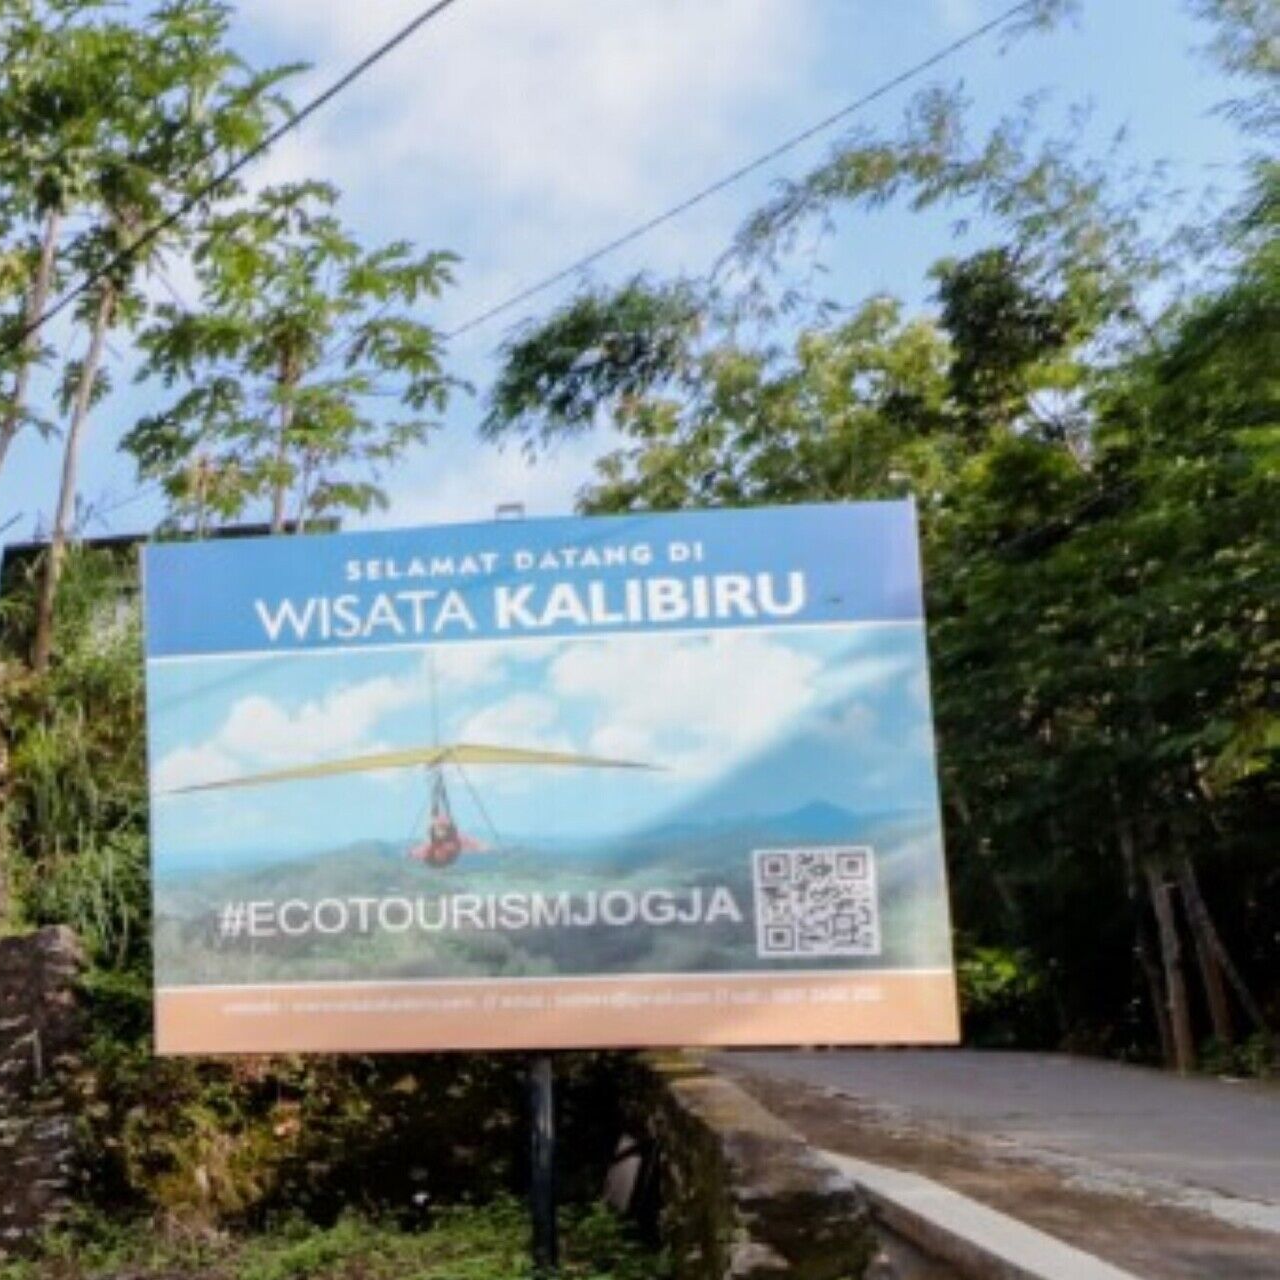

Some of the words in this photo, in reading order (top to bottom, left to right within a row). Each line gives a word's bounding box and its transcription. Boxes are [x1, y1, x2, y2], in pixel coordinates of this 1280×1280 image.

[346, 550, 498, 582] SELAMAT
[514, 542, 653, 572] DATANG
[669, 540, 704, 563] DI
[255, 589, 476, 642] WISATA
[494, 570, 807, 630] KALIBIRU
[219, 887, 742, 939] #ECOTOURISMJOGJA
